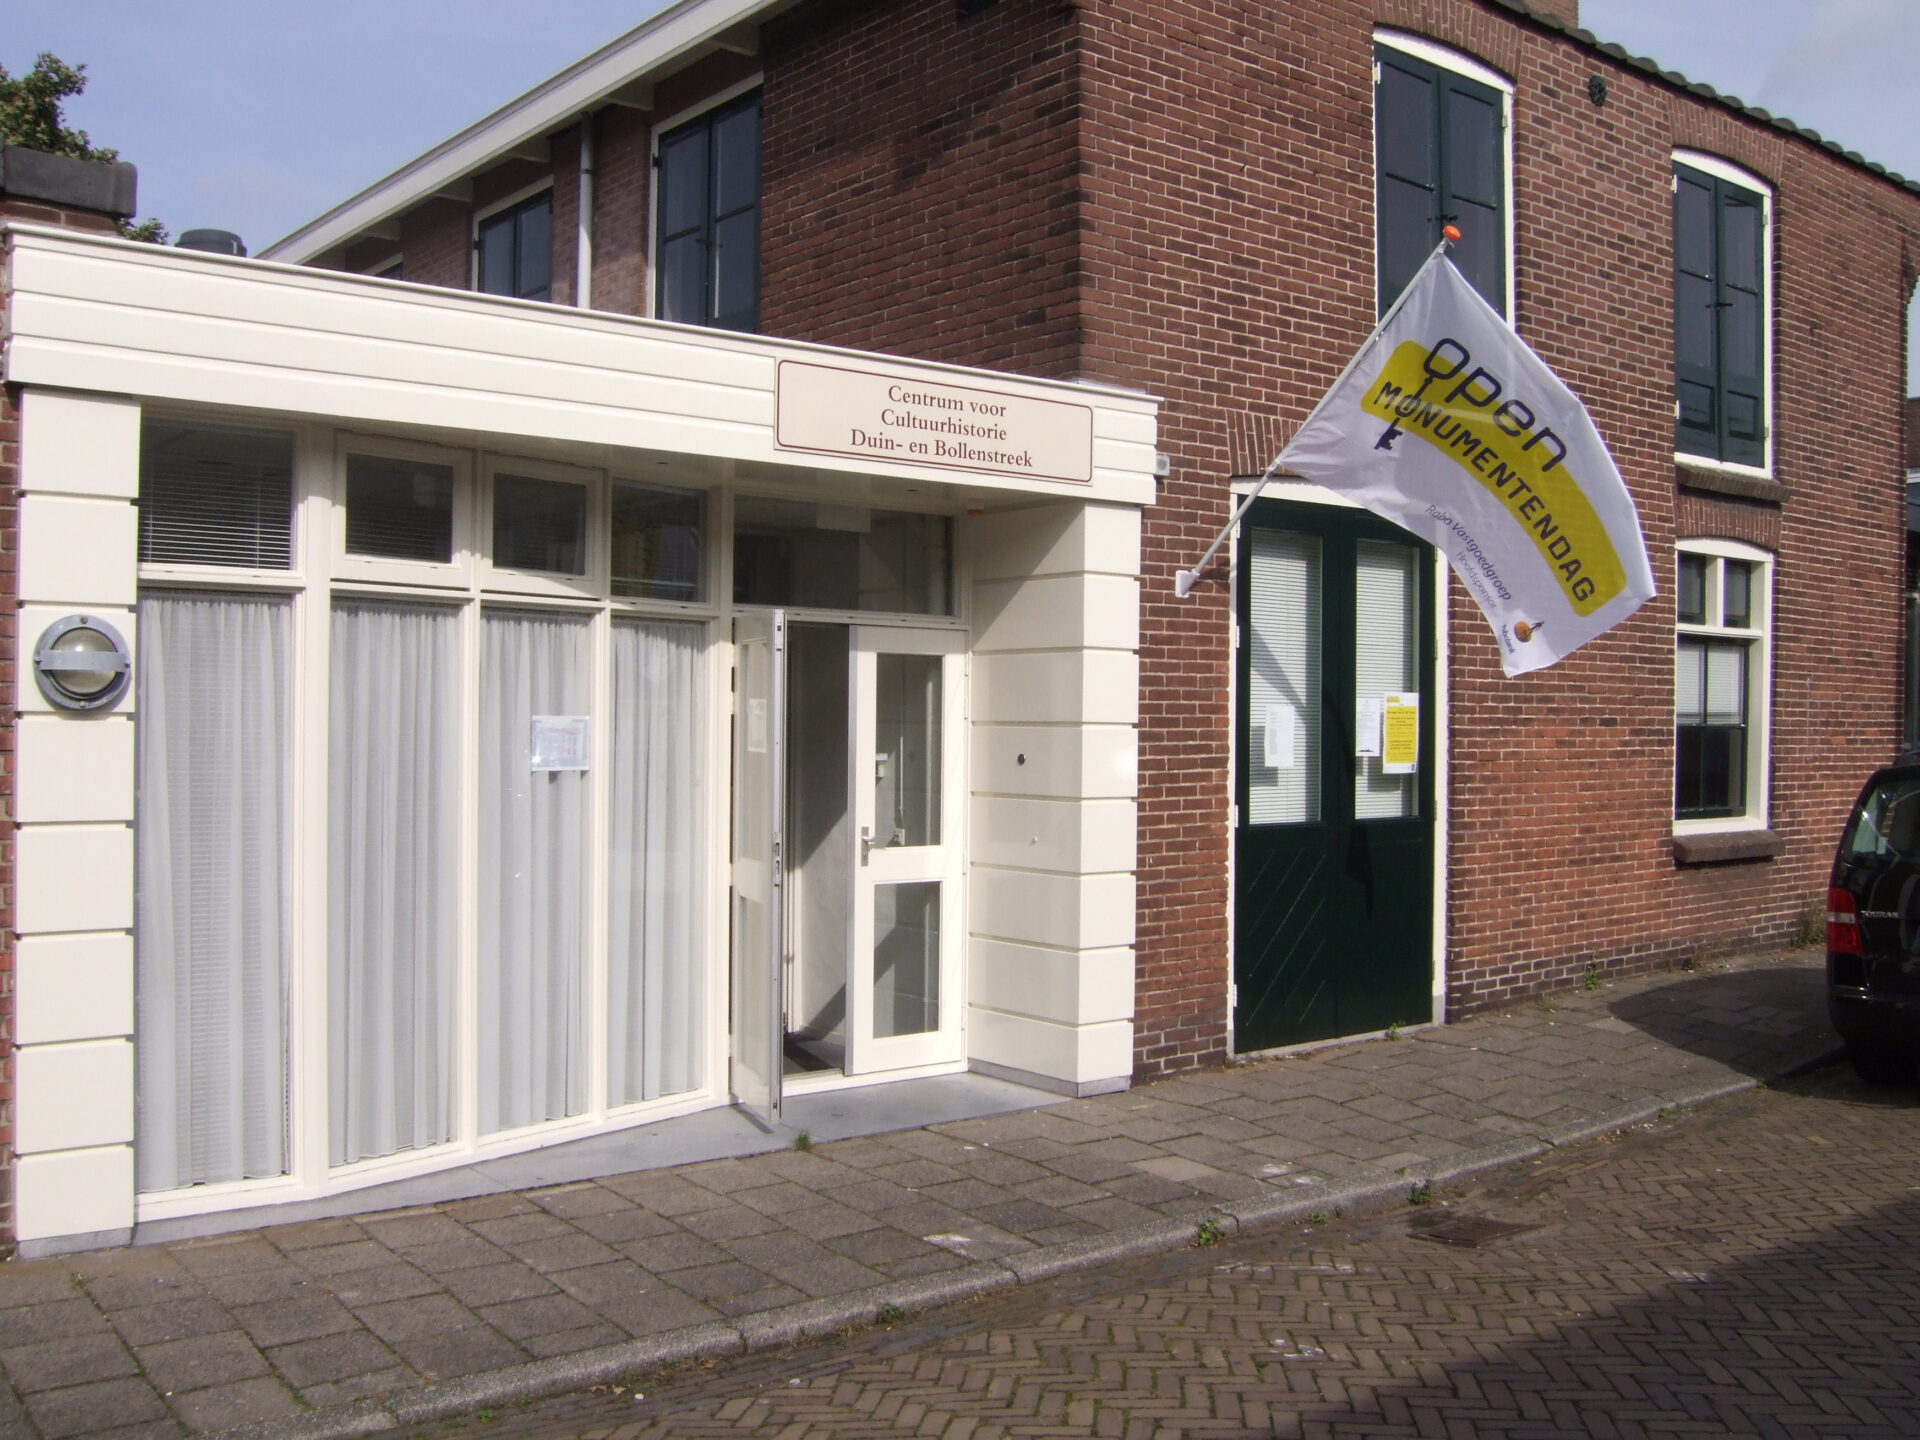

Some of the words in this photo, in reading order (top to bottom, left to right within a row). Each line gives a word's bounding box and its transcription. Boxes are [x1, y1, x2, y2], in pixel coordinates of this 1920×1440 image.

[881, 408, 1007, 441] Cultuurhistorie
[888, 385, 964, 411] Centrum
[969, 402, 1007, 417] voor
[1423, 338, 1567, 473] Open
[850, 429, 903, 451] Duin-
[909, 441, 928, 455] en
[934, 439, 1033, 468] Bollenstreek
[1373, 381, 1595, 602] MONUMENTENDAG
[1424, 504, 1453, 526] Rabo
[1452, 522, 1512, 600] Vastgoedgroep
[1456, 551, 1496, 608] Hoofdsponsor
